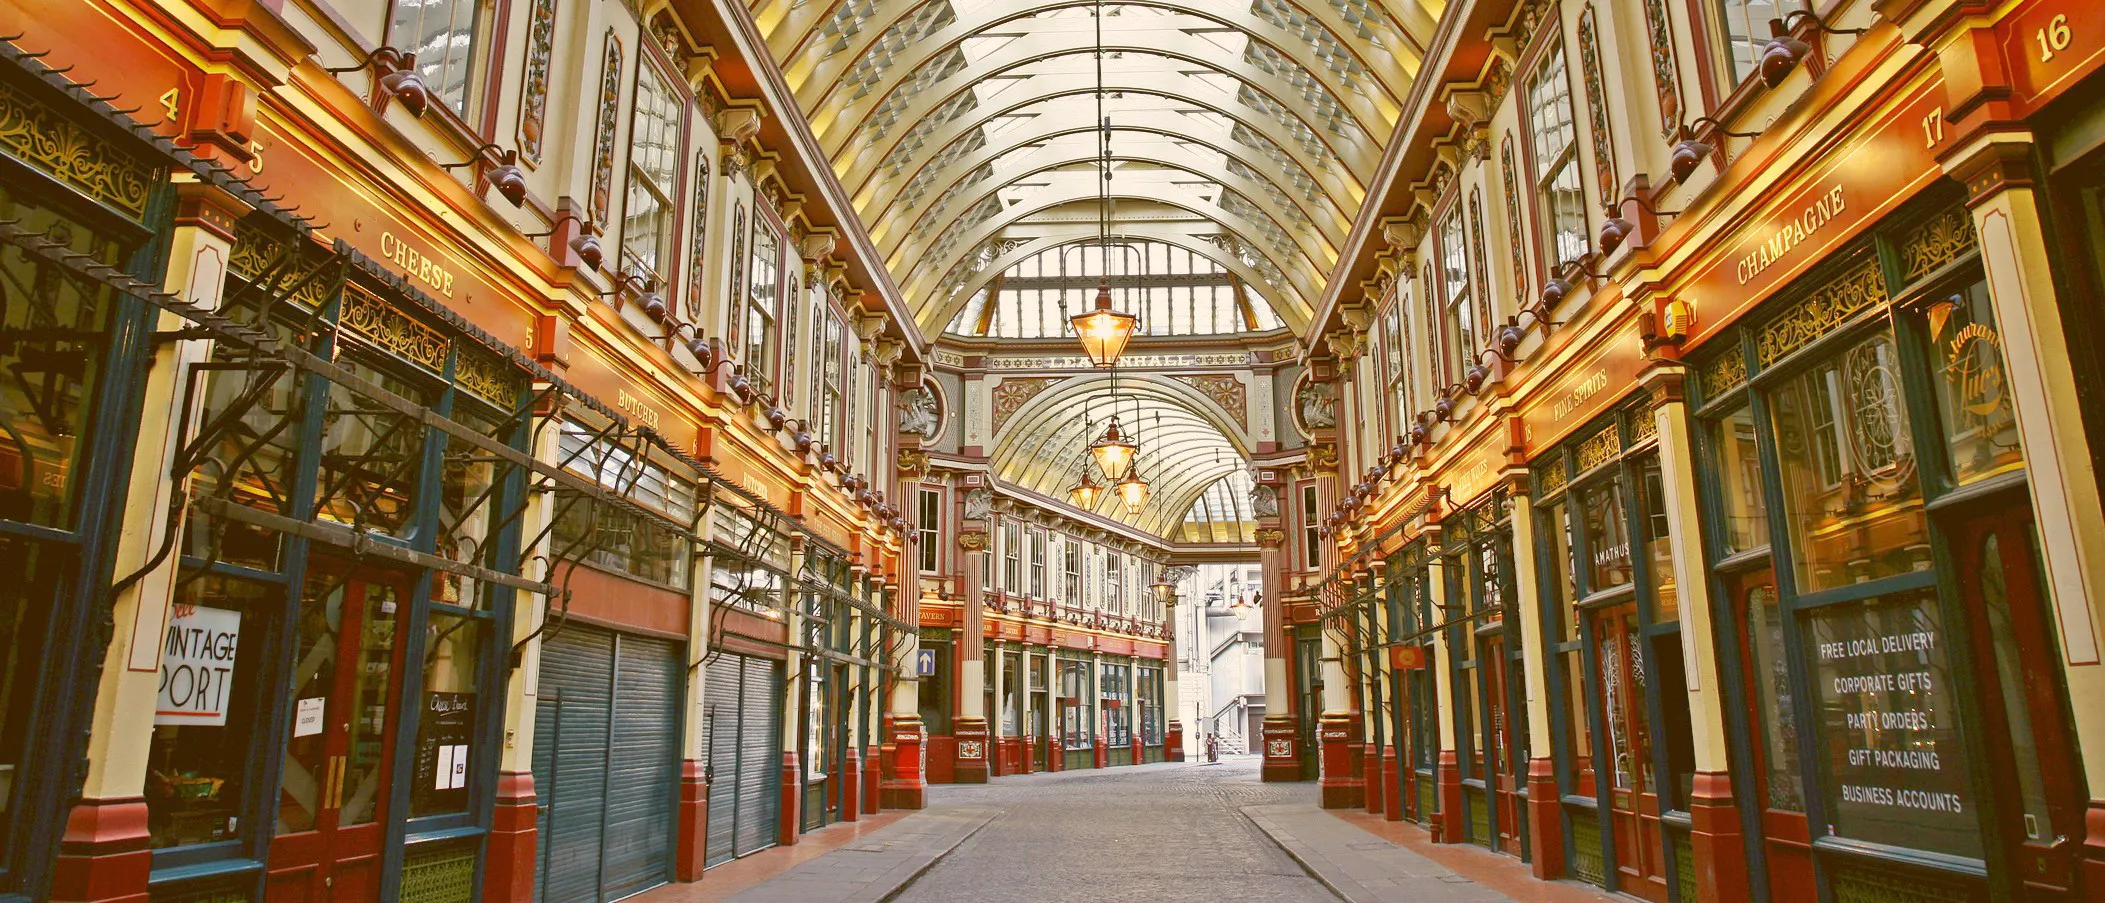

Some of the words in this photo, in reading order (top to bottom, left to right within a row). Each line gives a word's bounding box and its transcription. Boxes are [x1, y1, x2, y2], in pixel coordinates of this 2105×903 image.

[2037, 14, 2071, 62] 16
[160, 87, 179, 121] 4
[1922, 105, 1943, 149] 17
[249, 140, 264, 174] 5
[1737, 184, 1845, 285] CHAMPAGNE
[381, 231, 454, 298] CHEESE
[525, 326, 534, 350] 5
[1050, 354, 1191, 369] LEANHALL
[617, 389, 659, 431] BUTCHER
[1554, 394, 1573, 421] FINE
[1574, 368, 1607, 407] SPIRITS
[1595, 542, 1630, 567] AMATHUS
[1820, 642, 1845, 660] FREE
[1846, 638, 1879, 658] LOCAL
[1881, 631, 1935, 654] DELIVERY
[1834, 674, 1895, 694] CORPORATE
[1897, 672, 1932, 690] GIFTS
[1847, 712, 1879, 730] PARTY
[1881, 711, 1928, 730] ORDERS
[1848, 748, 1872, 767] GIFT
[1874, 750, 1940, 770] PACKAGING
[1842, 784, 1894, 806] BUSINESS
[1896, 789, 1962, 813] ACCOUNTS
